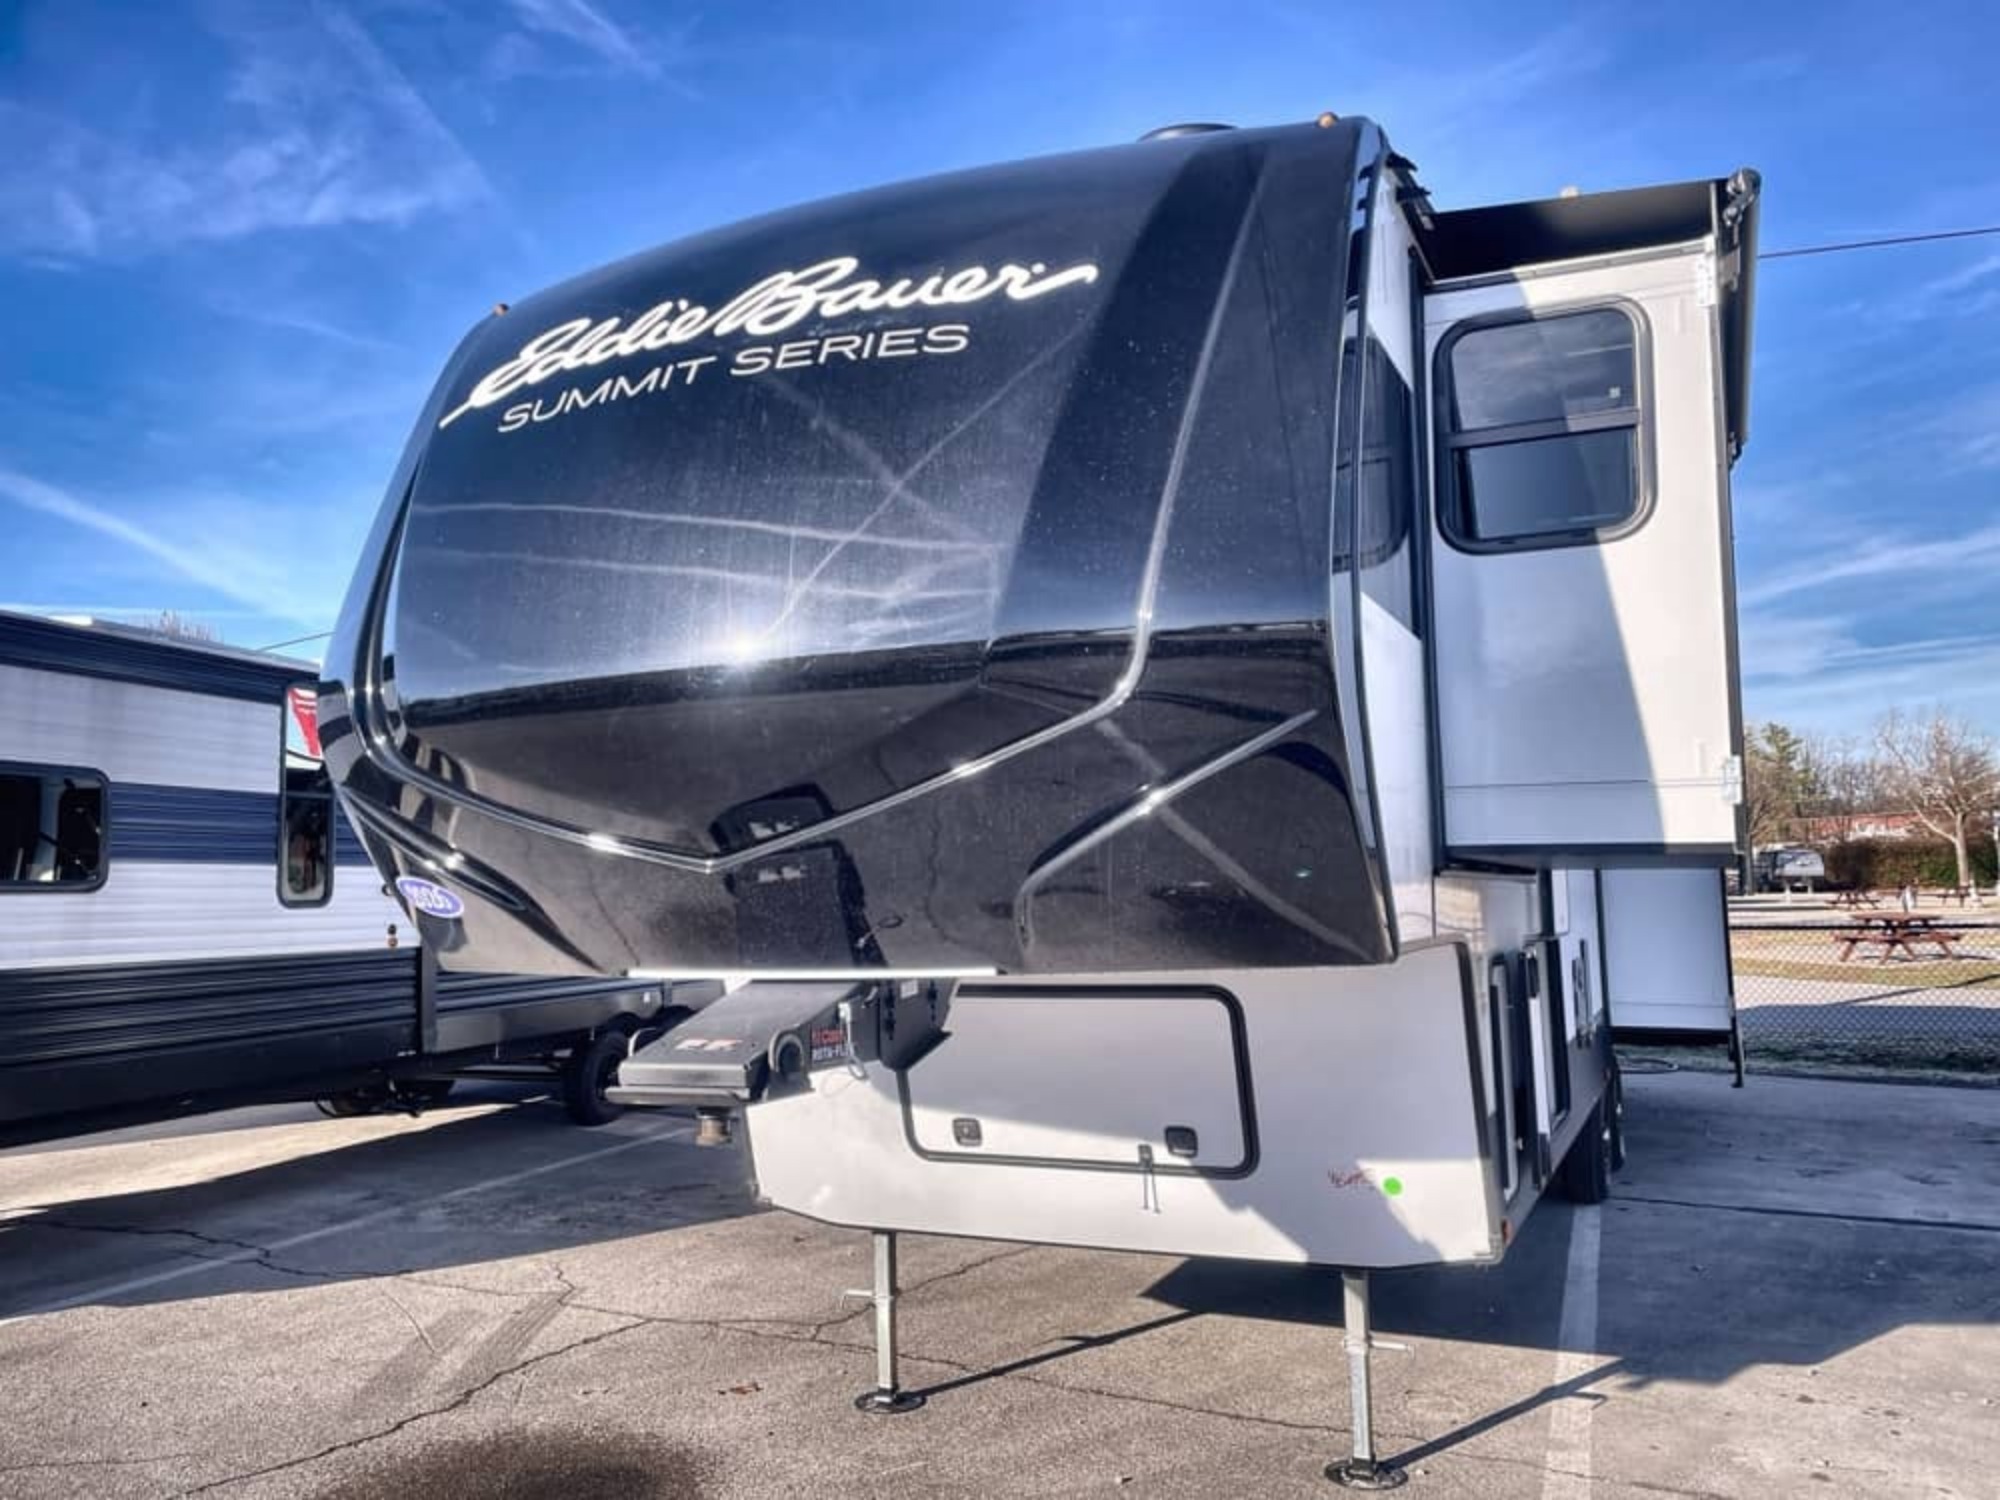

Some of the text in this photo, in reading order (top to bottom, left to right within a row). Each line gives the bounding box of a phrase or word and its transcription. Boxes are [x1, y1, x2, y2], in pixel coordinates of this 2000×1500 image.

[440, 257, 1098, 428] Eddie Bauer
[499, 325, 970, 432] SUMMIT SERIES
